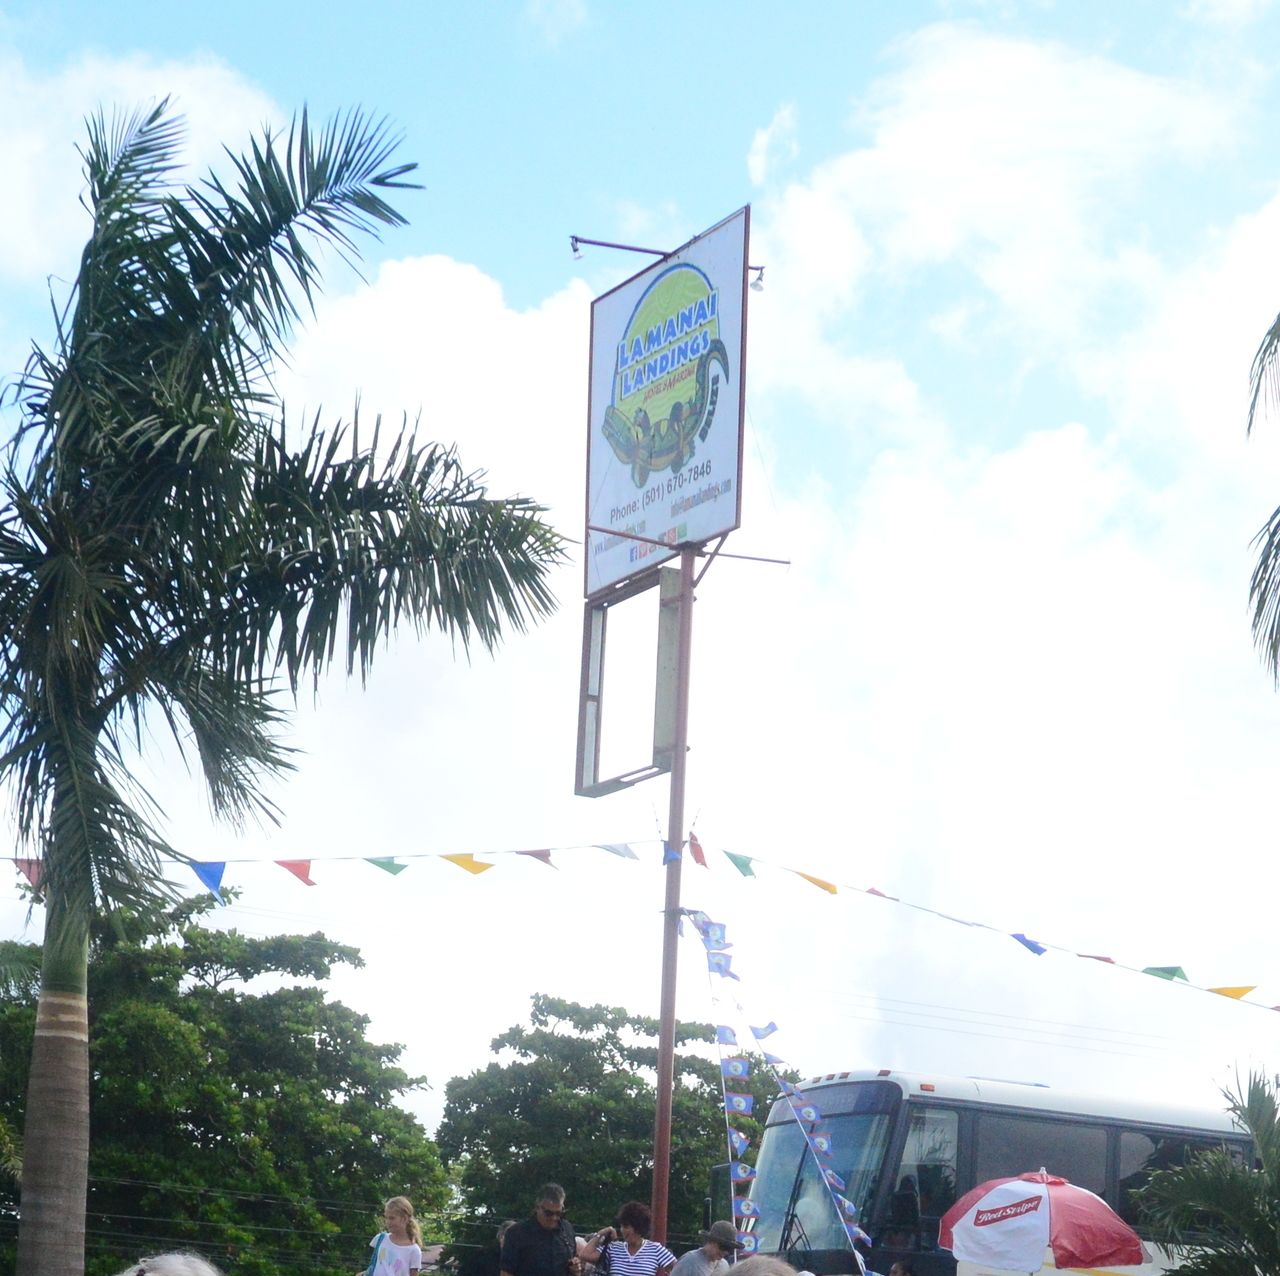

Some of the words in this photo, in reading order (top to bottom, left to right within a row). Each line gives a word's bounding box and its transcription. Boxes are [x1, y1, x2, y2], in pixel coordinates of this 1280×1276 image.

[619, 292, 718, 369] LAMANAI
[622, 330, 710, 397] LANDINGS
[699, 374, 719, 443] BELIZE
[610, 501, 640, 525] Phone:
[642, 483, 665, 511] (501)
[666, 460, 712, 494] 670-7846
[978, 1211, 1003, 1223] Red
[1003, 1201, 1038, 1215] Stripe
